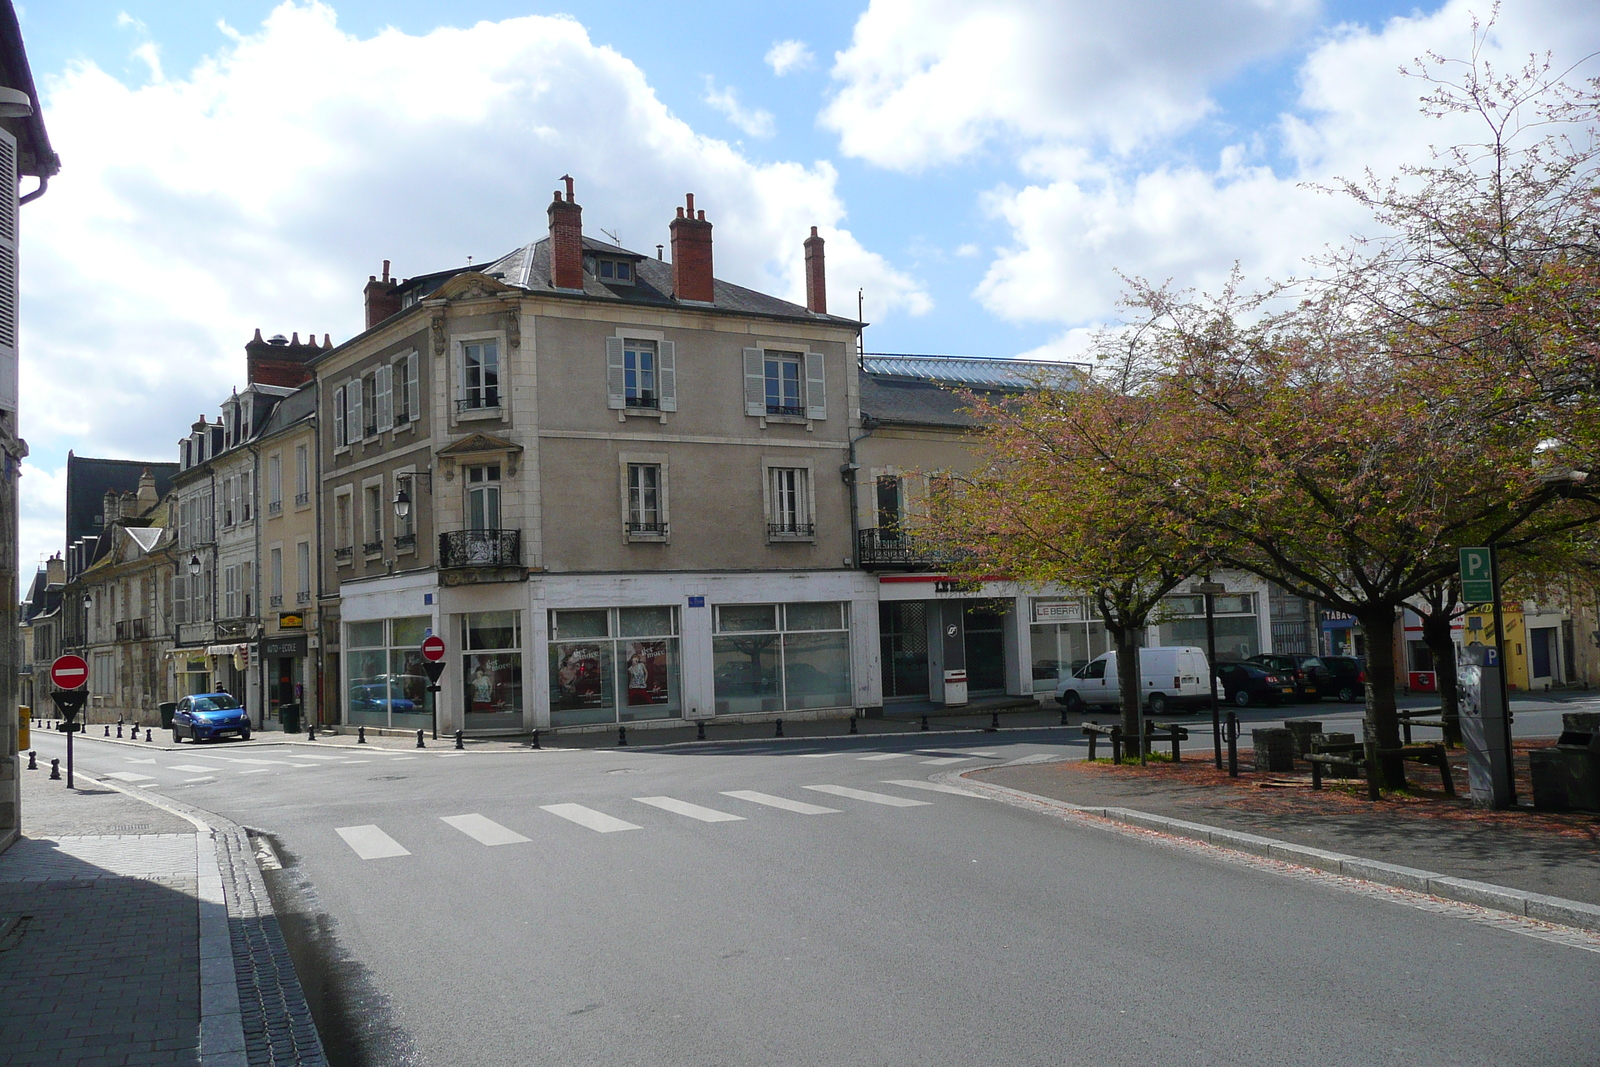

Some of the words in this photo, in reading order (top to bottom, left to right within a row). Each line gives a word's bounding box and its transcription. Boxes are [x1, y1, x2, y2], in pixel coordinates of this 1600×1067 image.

[1468, 553, 1482, 576] P
[1037, 607, 1049, 616] LE
[1050, 606, 1080, 615] BERRY
[579, 651, 599, 660] more
[646, 649, 665, 659] more
[1488, 648, 1498, 665] P
[491, 662, 511, 671] more
